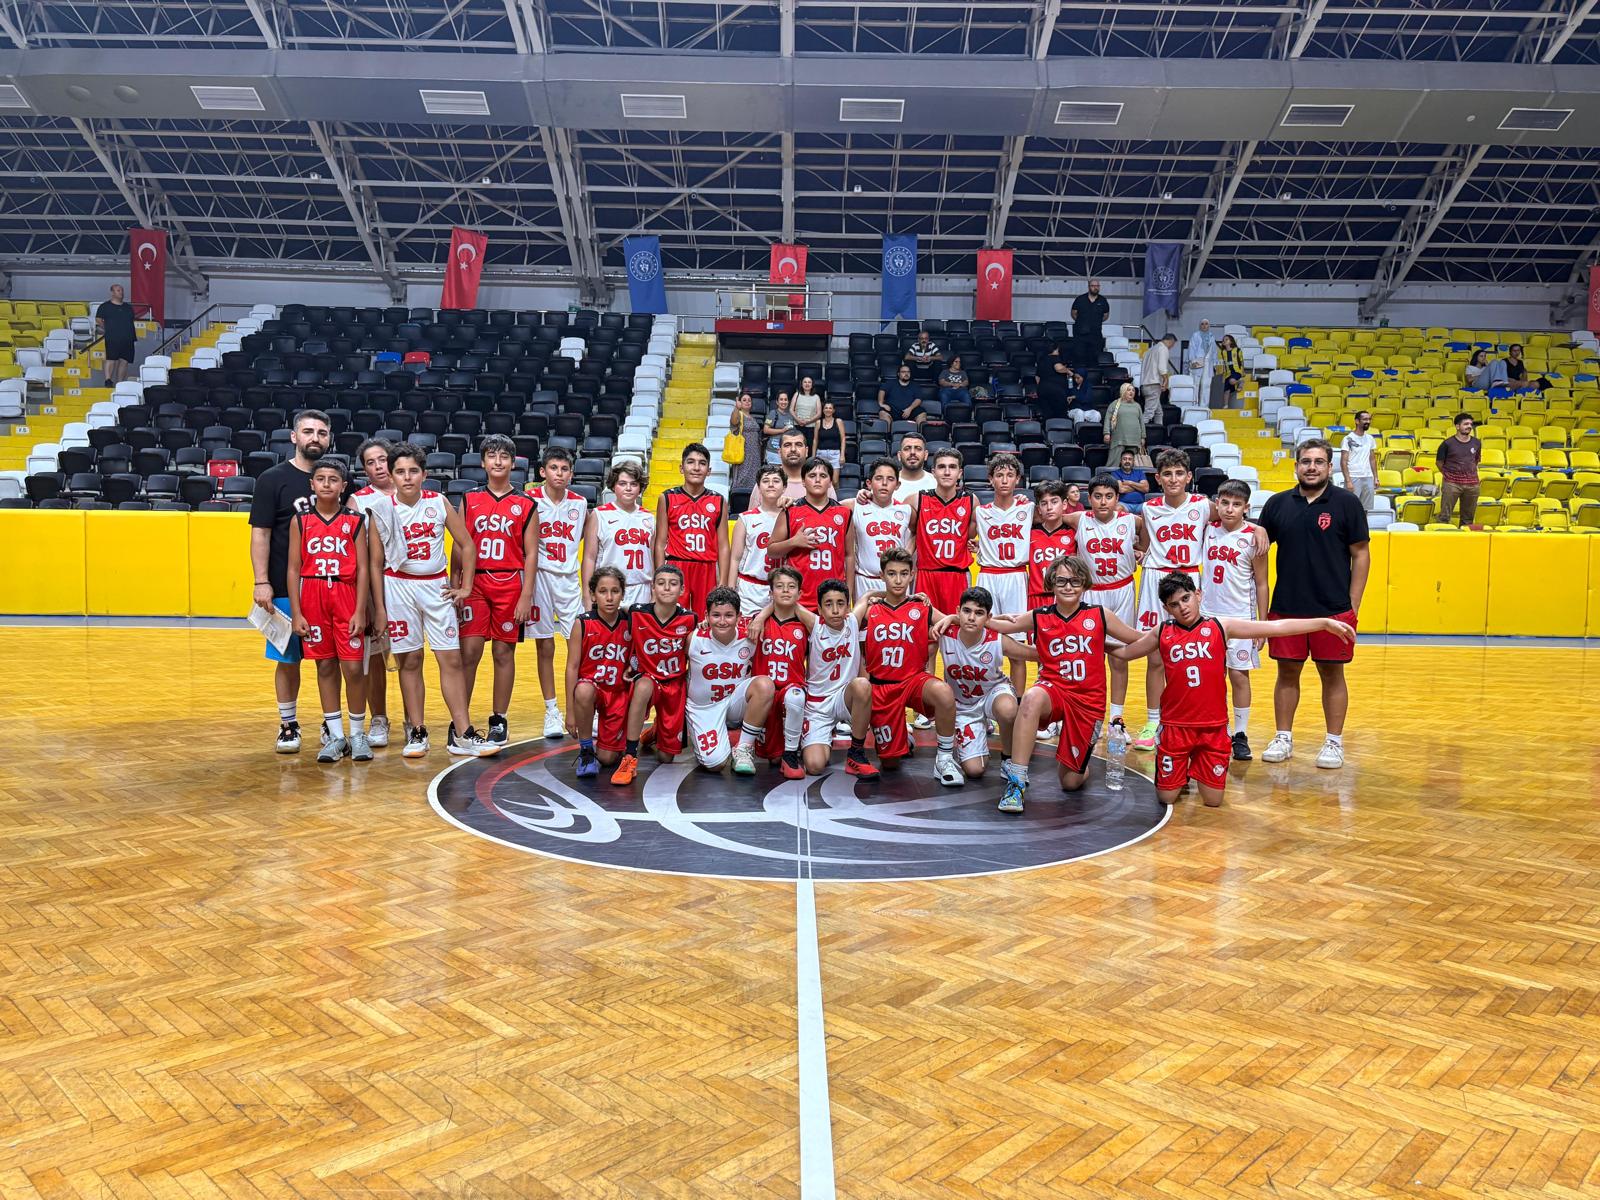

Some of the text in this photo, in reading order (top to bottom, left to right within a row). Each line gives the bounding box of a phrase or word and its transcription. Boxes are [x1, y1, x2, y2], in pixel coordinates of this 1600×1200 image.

[474, 513, 513, 537] GSK
[539, 520, 575, 541] GSK
[678, 513, 711, 531] GSK
[866, 521, 902, 538] GSK
[925, 517, 962, 536] GSK
[987, 523, 1024, 540] GSK
[614, 528, 650, 548] GSK
[685, 533, 706, 552] 50
[1156, 523, 1198, 543] GSK
[307, 536, 348, 556] GSK
[407, 541, 431, 560] 23
[478, 537, 505, 560] 90
[545, 542, 567, 562] 50
[933, 539, 955, 559] 70
[998, 542, 1016, 560] 10
[1033, 547, 1067, 564] GSK
[1086, 538, 1125, 555] GSK
[1165, 544, 1190, 564] 40
[1207, 545, 1241, 566] GSK
[315, 558, 339, 576] 33
[624, 549, 644, 570] 70
[809, 549, 832, 571] 99
[1094, 557, 1118, 577] 35
[1212, 565, 1225, 584] 9
[1138, 610, 1158, 627] 40
[387, 620, 409, 638] 23
[873, 622, 915, 643] GSK
[589, 643, 628, 663] GSK
[643, 638, 683, 655] GSK
[762, 638, 798, 660] GSK
[822, 642, 852, 662] GSK
[1049, 635, 1094, 657] GSK
[1169, 641, 1213, 664] GSK
[593, 664, 618, 686] 23
[656, 656, 680, 676] 40
[702, 662, 745, 680] GSK
[767, 660, 789, 682] 35
[946, 664, 989, 682] GSK
[1059, 659, 1086, 681] 20
[1186, 665, 1201, 688] 9
[958, 684, 985, 699] 34
[697, 729, 719, 751] 33
